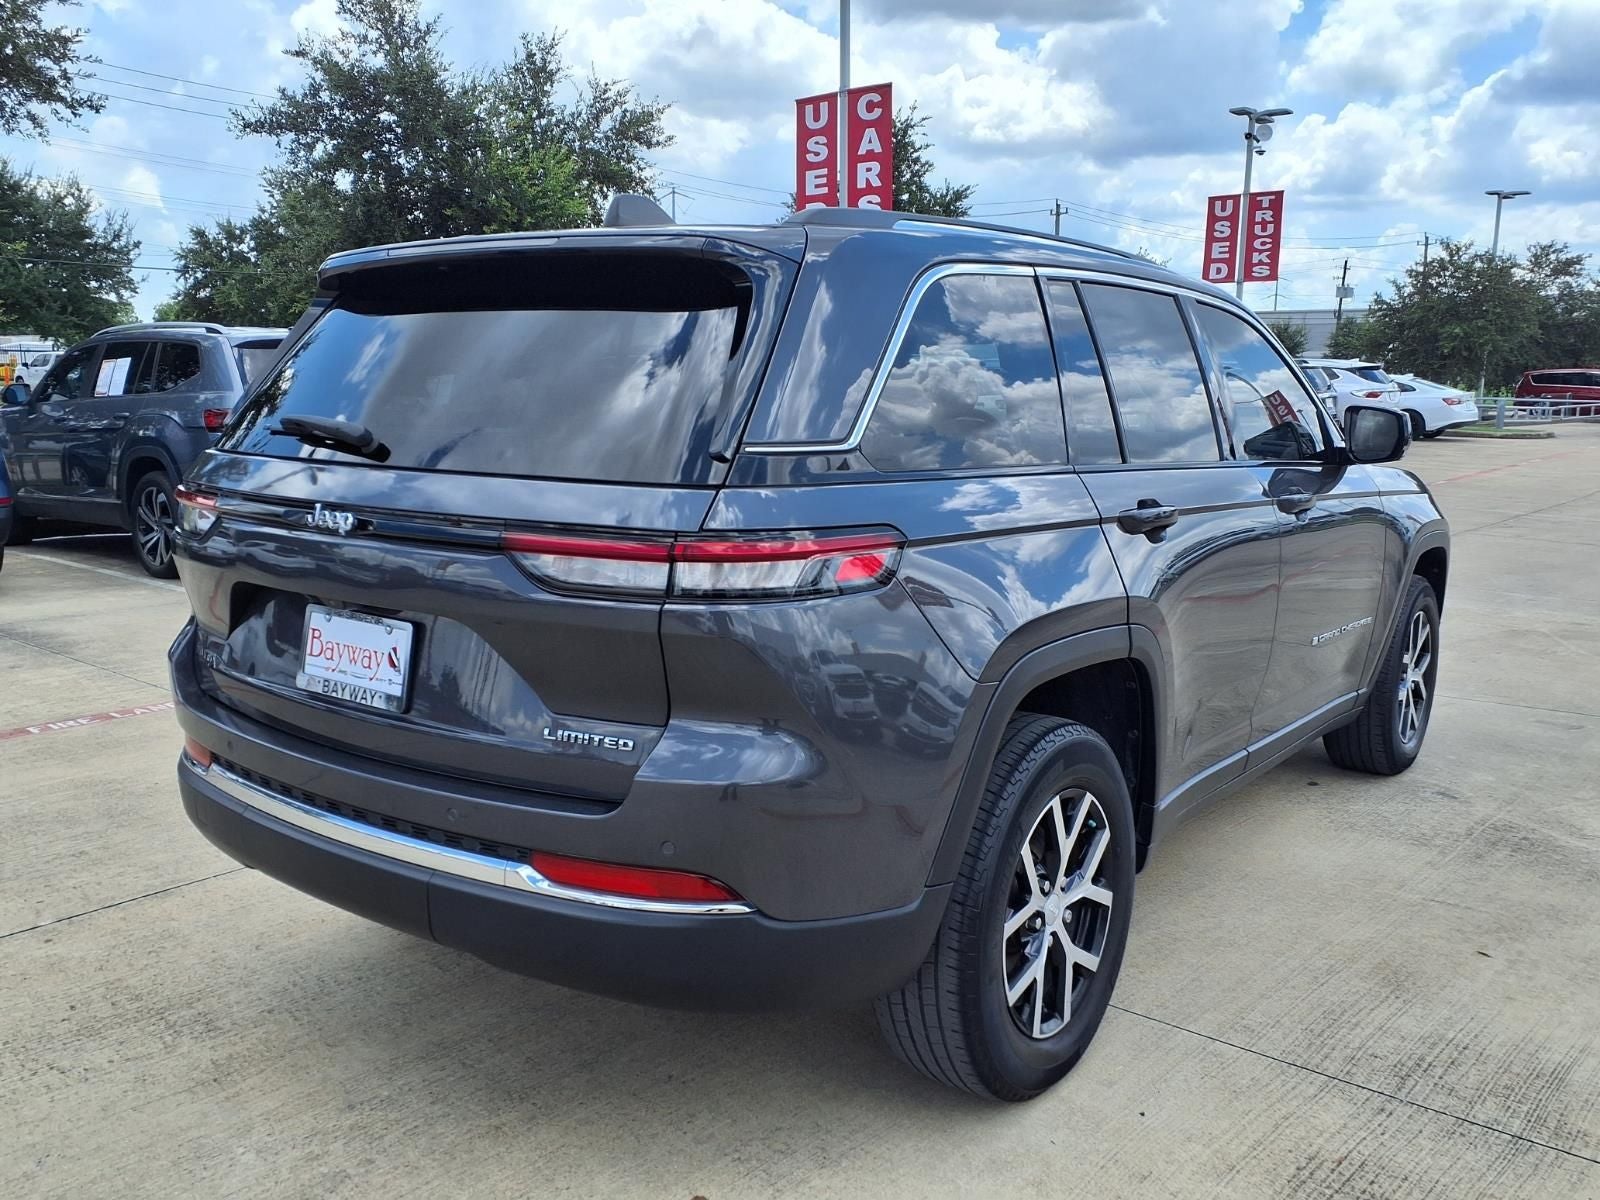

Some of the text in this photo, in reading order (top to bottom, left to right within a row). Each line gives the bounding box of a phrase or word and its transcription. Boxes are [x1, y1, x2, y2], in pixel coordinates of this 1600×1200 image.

[805, 101, 829, 209] USE
[1209, 200, 1234, 279] USED
[1251, 196, 1276, 277] TRUCKS
[305, 503, 354, 536] Jeep
[307, 627, 385, 681] Bayway
[321, 679, 378, 705] BAYWAY
[26, 716, 101, 734] FIRE
[543, 727, 635, 752] LIMITED
